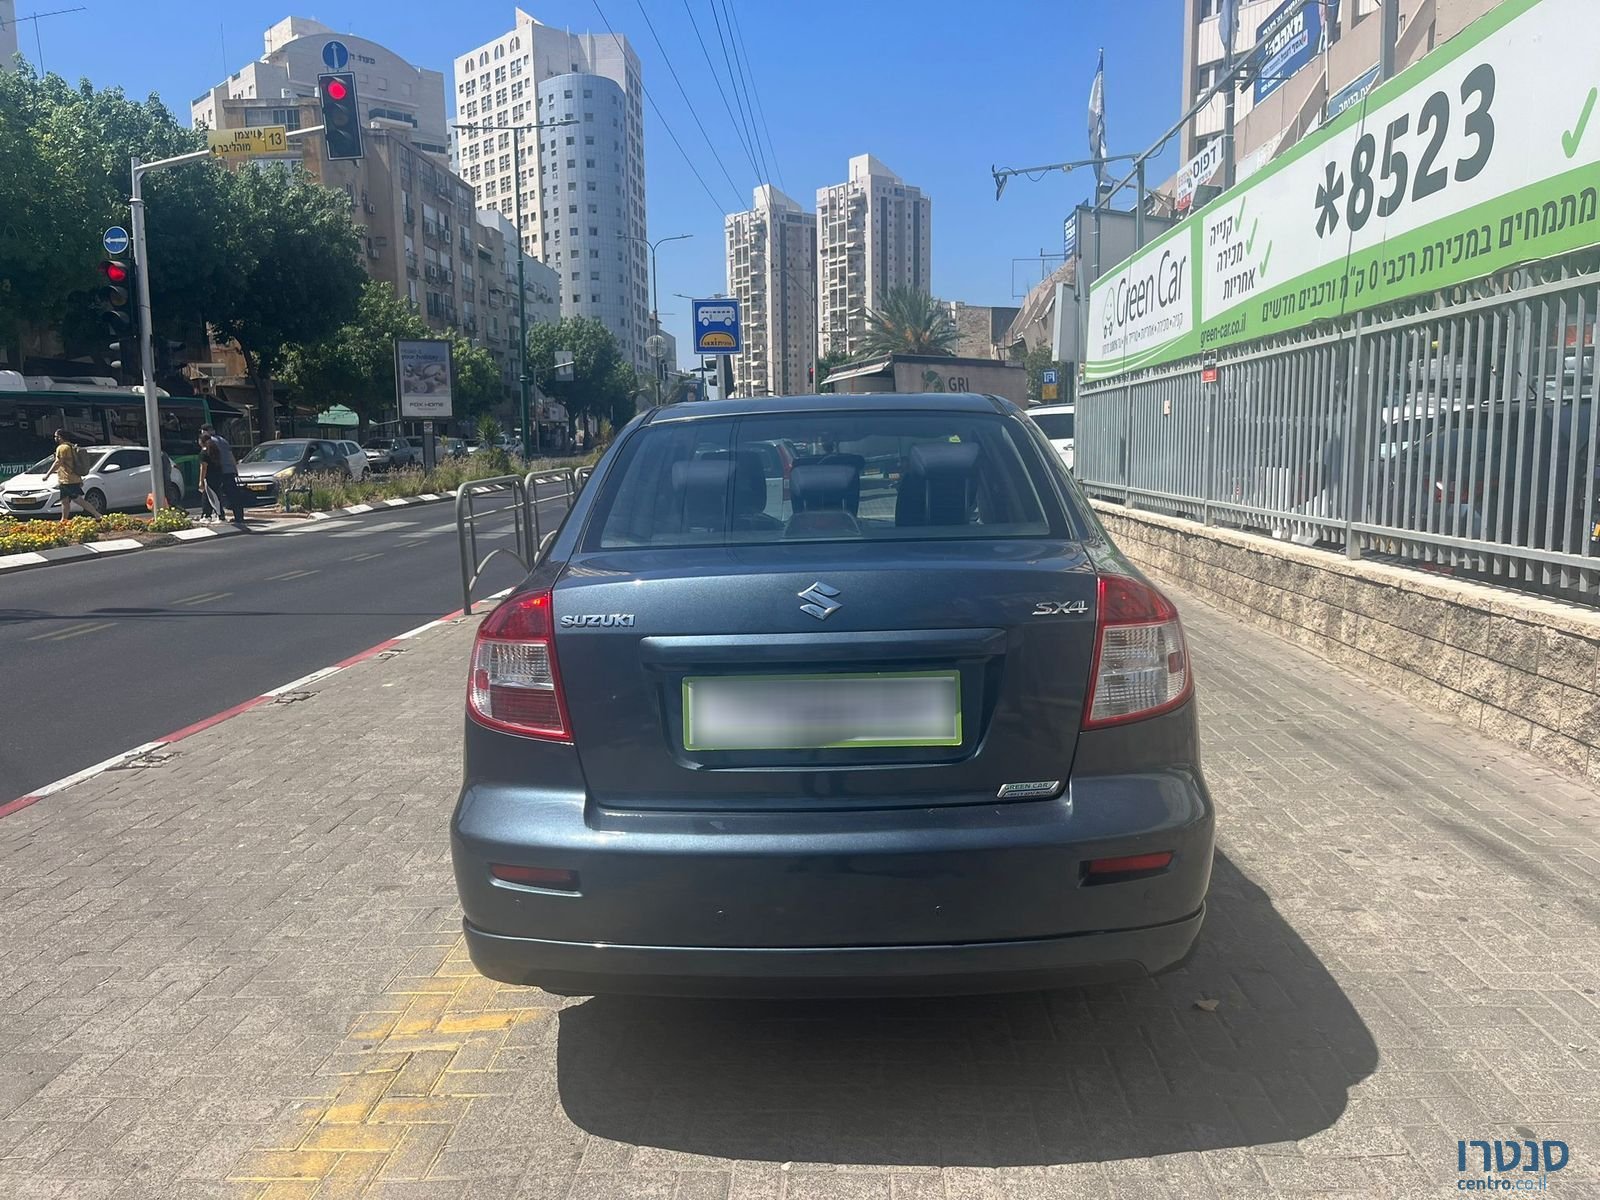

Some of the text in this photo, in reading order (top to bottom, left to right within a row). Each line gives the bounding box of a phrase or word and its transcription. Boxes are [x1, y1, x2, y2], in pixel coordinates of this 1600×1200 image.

[218, 141, 251, 153] מוהליבר
[234, 129, 256, 142] ויצמן
[269, 132, 282, 146] 13
[1193, 145, 1217, 179] דפוס
[1210, 216, 1233, 247] קנייה
[1498, 186, 1597, 249] מתמחים
[1216, 241, 1243, 273] מכירה
[1420, 224, 1492, 275] במכירת
[1223, 267, 1256, 301] אחריות
[1382, 251, 1416, 286] רכבי
[1117, 249, 1186, 328] Green Car
[1298, 278, 1336, 312] ורכבים
[1262, 292, 1296, 323] חדשים
[1200, 311, 1247, 349] green-car.co.il
[560, 613, 636, 629] SUZUKI
[1032, 600, 1089, 615] SX4
[1004, 783, 1031, 791] GREEN
